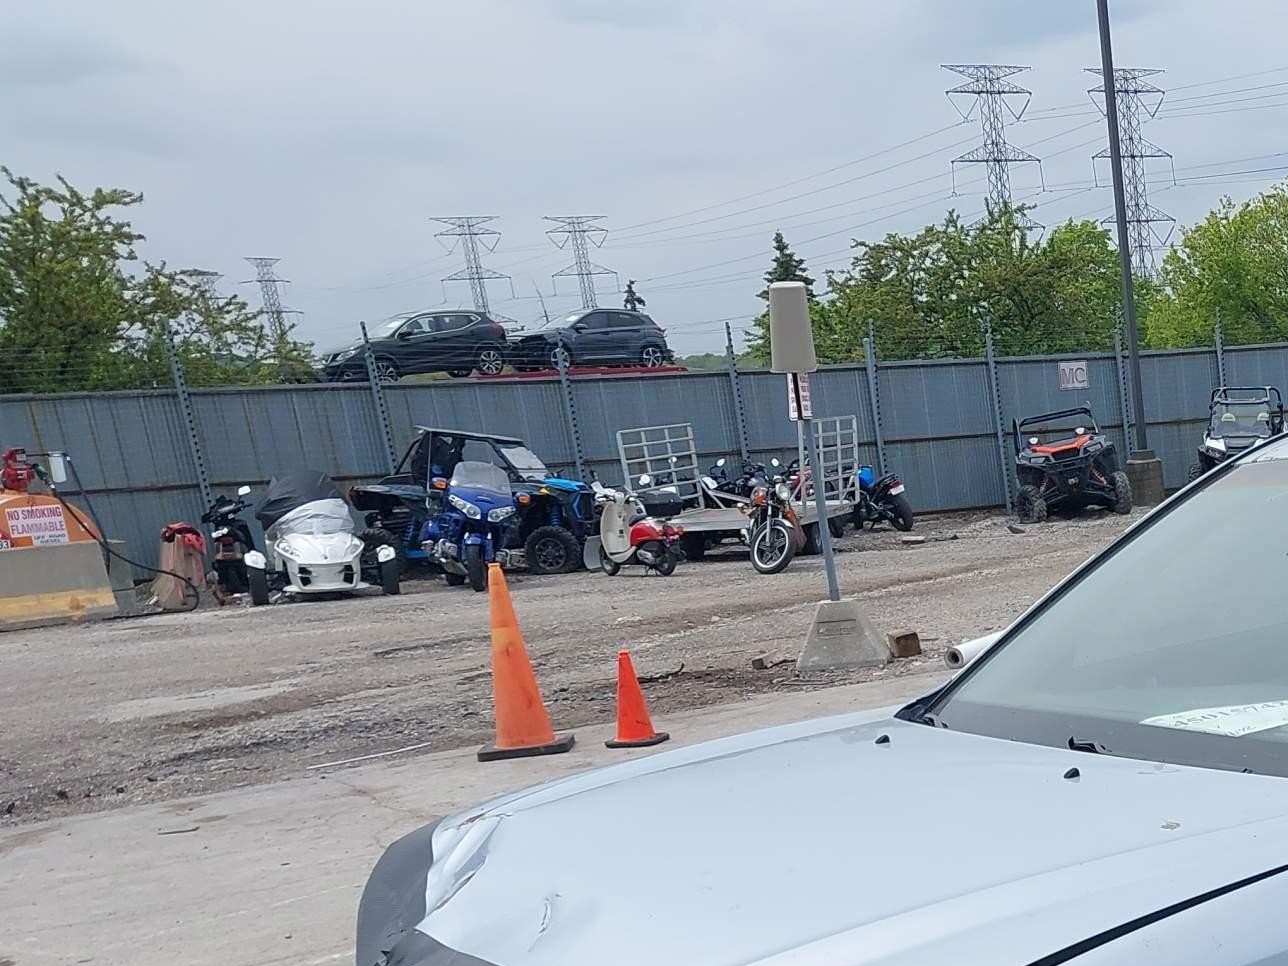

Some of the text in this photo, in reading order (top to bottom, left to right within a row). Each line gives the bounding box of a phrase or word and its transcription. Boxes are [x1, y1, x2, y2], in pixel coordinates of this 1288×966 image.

[1061, 367, 1087, 384] MC
[7, 506, 62, 521] NO SMOKING
[11, 520, 65, 535] FLAMMABLE
